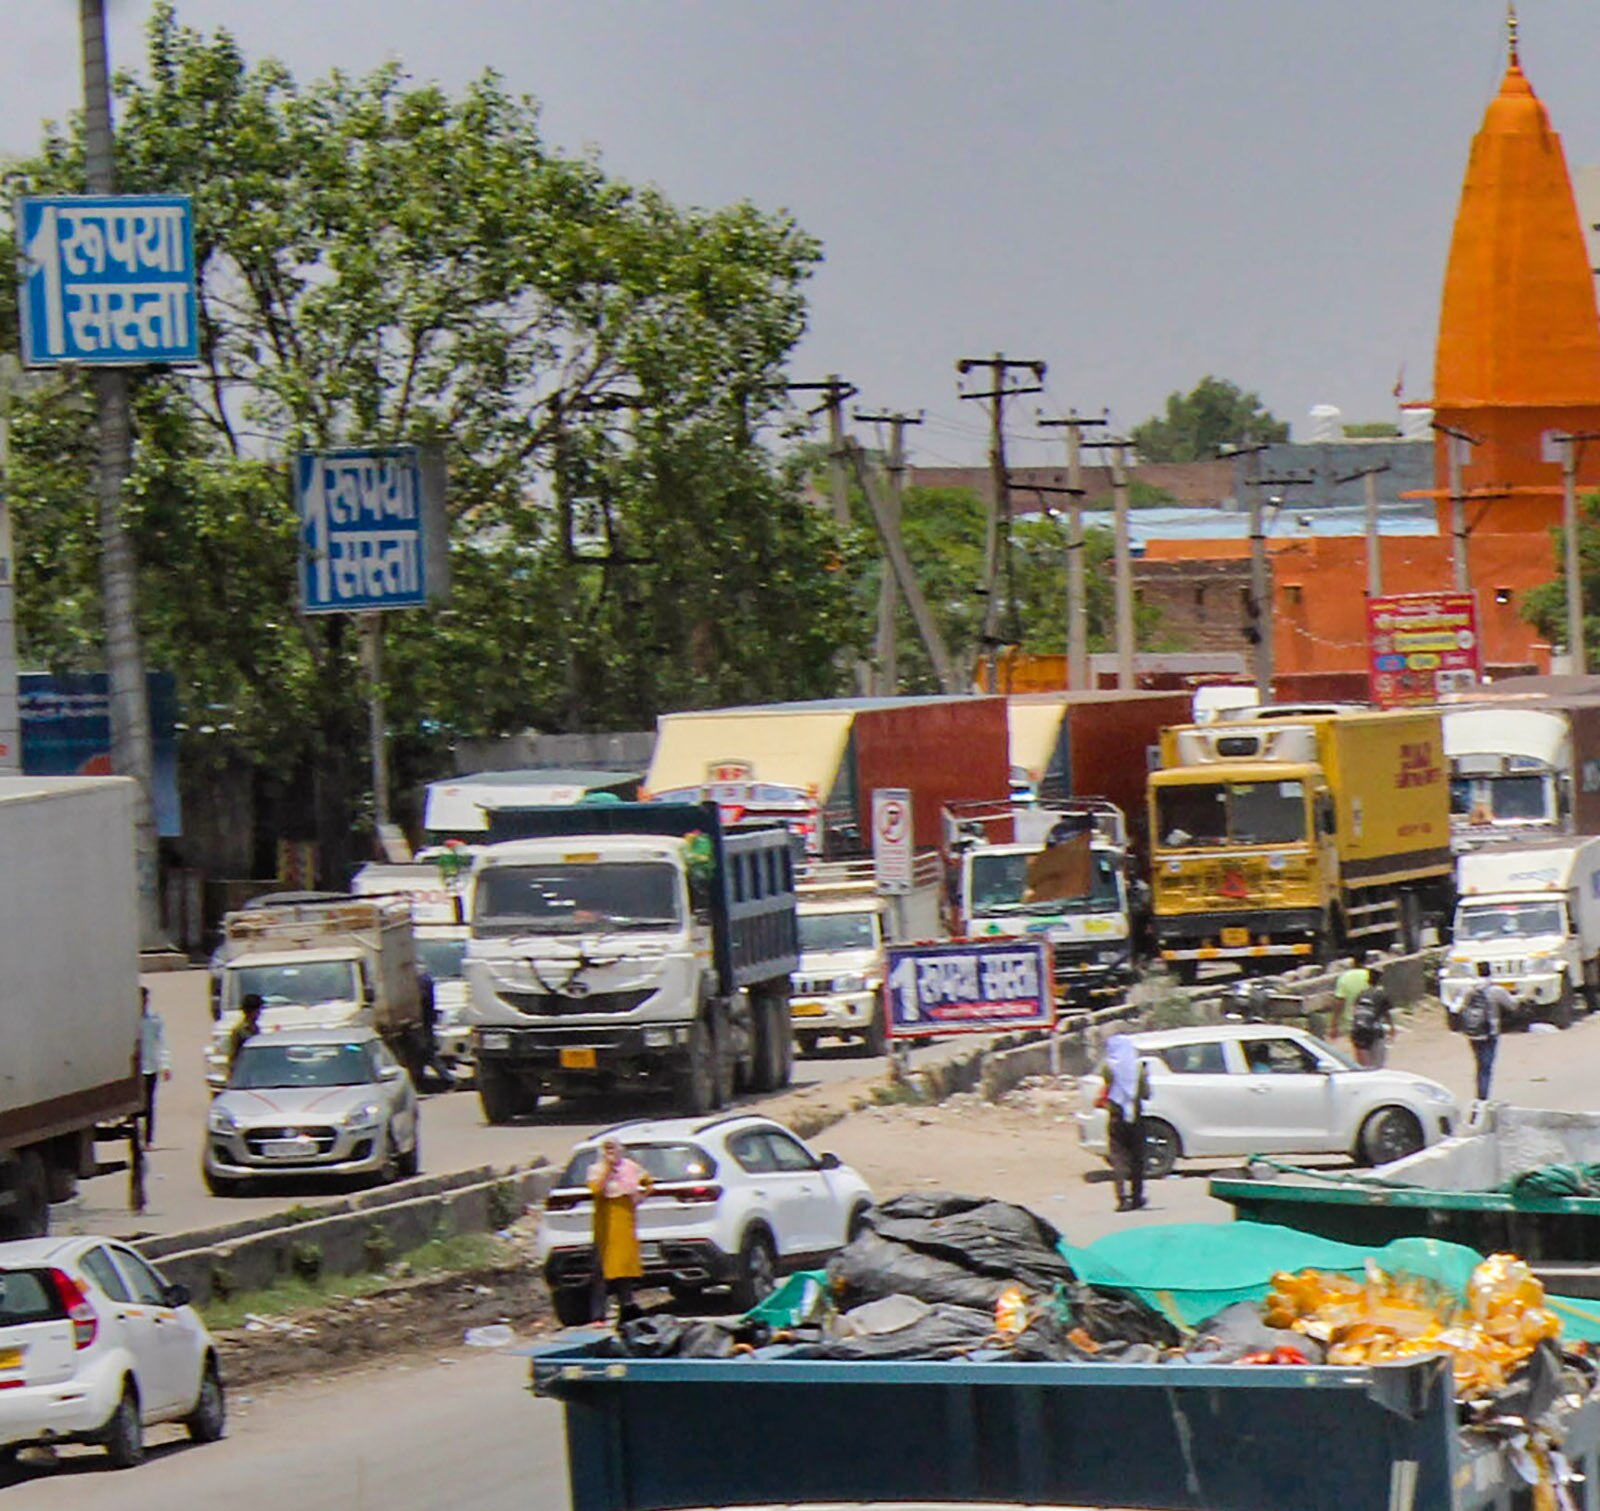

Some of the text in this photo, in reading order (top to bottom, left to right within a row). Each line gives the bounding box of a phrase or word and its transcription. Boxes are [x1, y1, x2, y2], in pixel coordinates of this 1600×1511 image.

[27, 206, 65, 355] 1
[65, 282, 188, 354] सस्ता
[301, 458, 328, 602] 1
[328, 530, 418, 598] सस्ता
